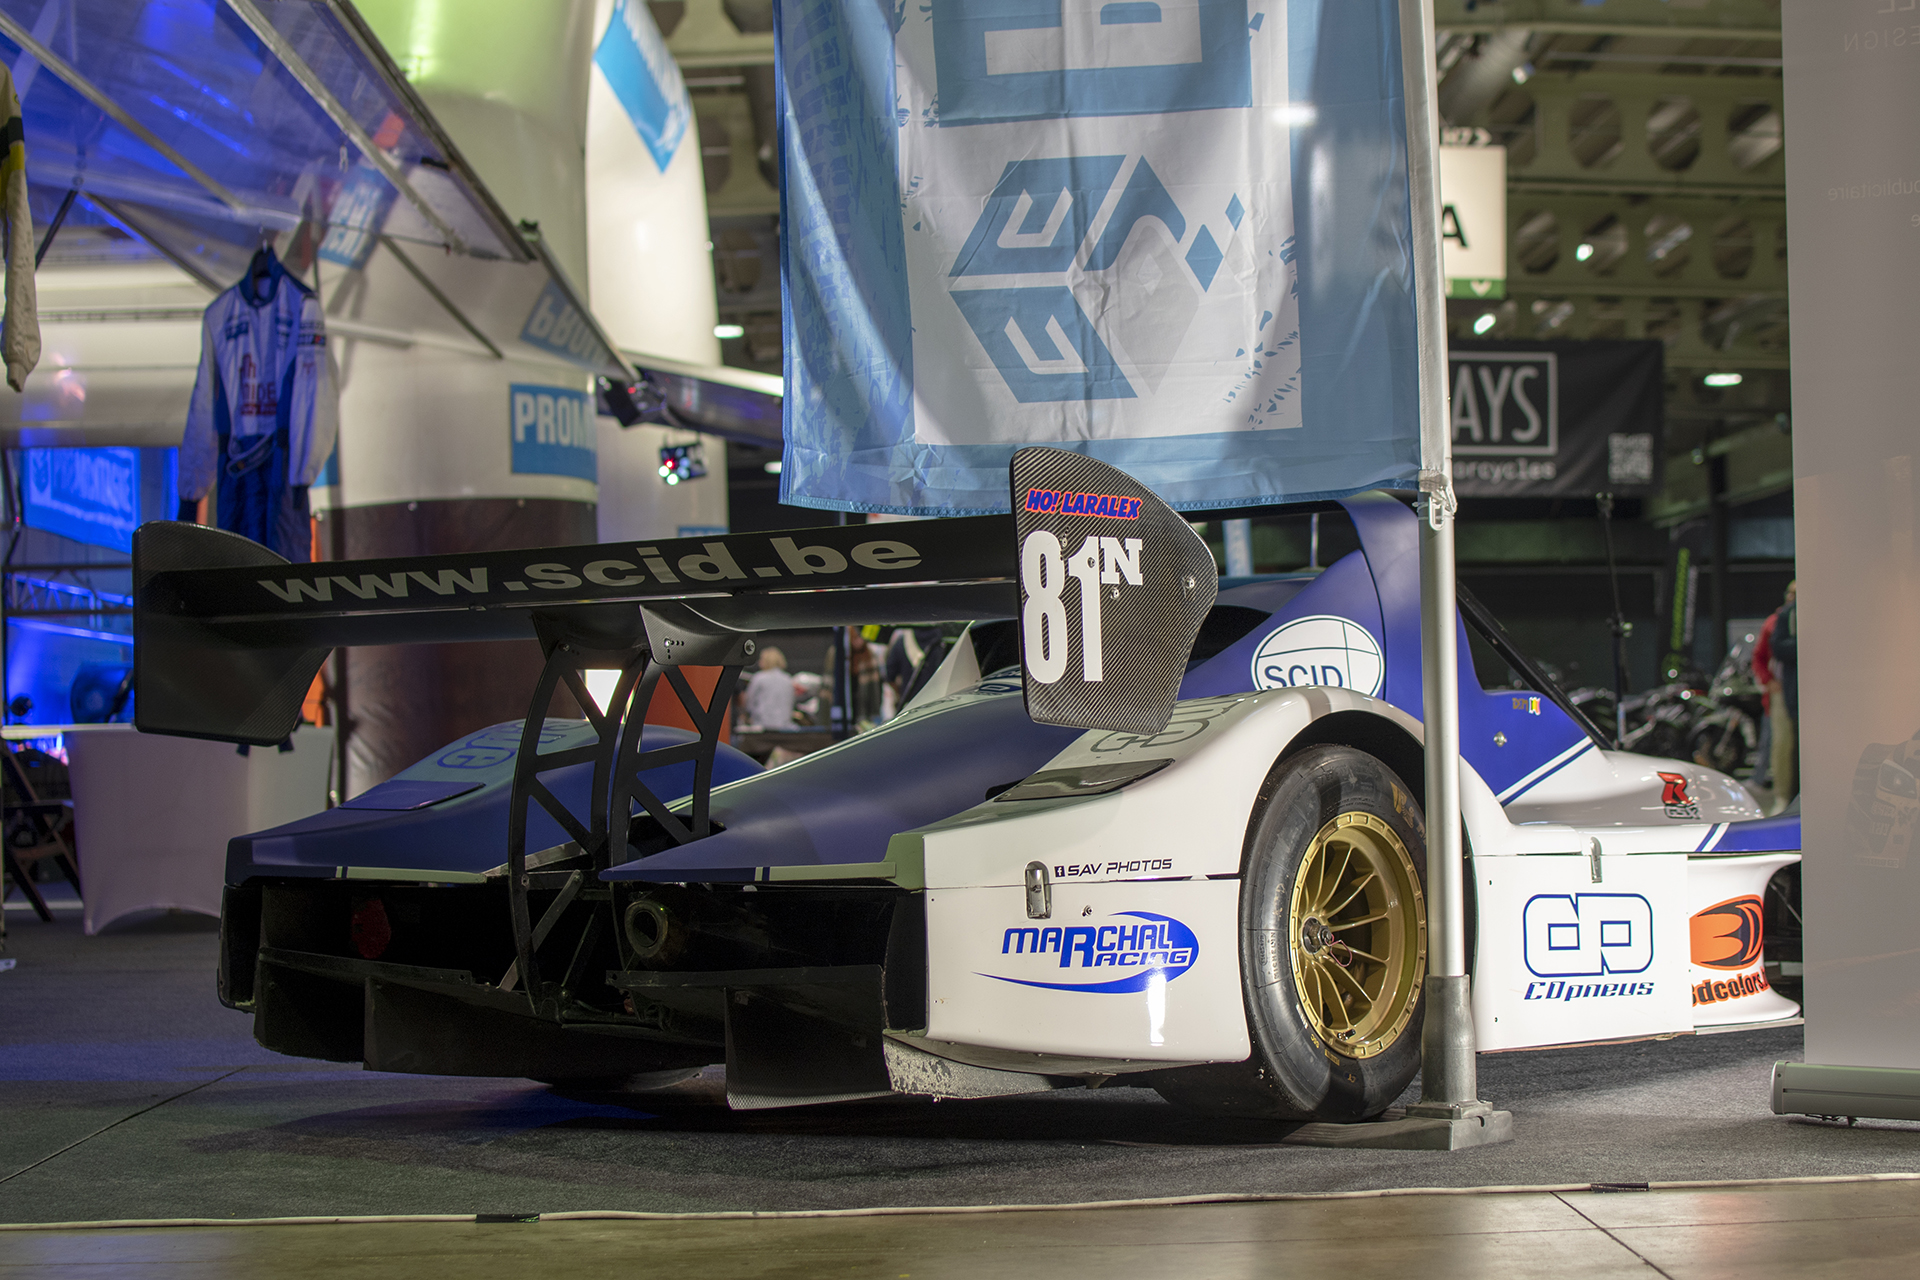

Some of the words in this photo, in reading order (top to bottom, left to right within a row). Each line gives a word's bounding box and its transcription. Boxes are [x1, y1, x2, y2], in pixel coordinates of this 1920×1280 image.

[1451, 364, 1542, 443] AYS
[1025, 488, 1061, 514] HO!
[1060, 490, 1143, 520] LARALEX
[257, 537, 922, 603] www.scid.be
[1264, 665, 1343, 689] SCID
[1067, 863, 1102, 877] SAV
[1106, 858, 1173, 875] PHOTOS
[1094, 950, 1189, 967] RACING
